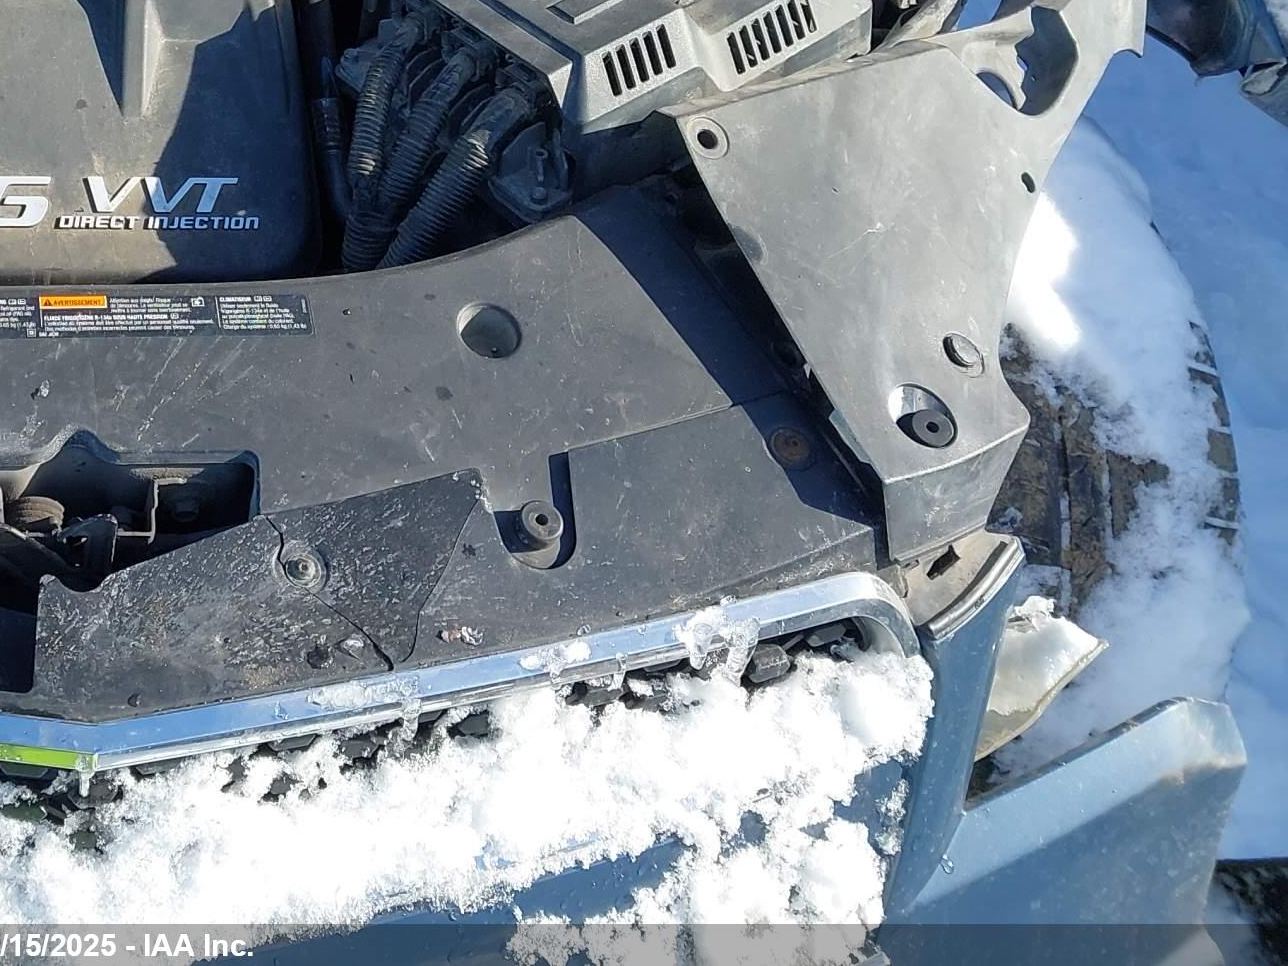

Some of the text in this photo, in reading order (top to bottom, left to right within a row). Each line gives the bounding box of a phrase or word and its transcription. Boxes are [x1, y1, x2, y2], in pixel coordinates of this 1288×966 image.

[82, 175, 239, 214] VVT
[55, 215, 260, 231] DIRECT INJECTION
